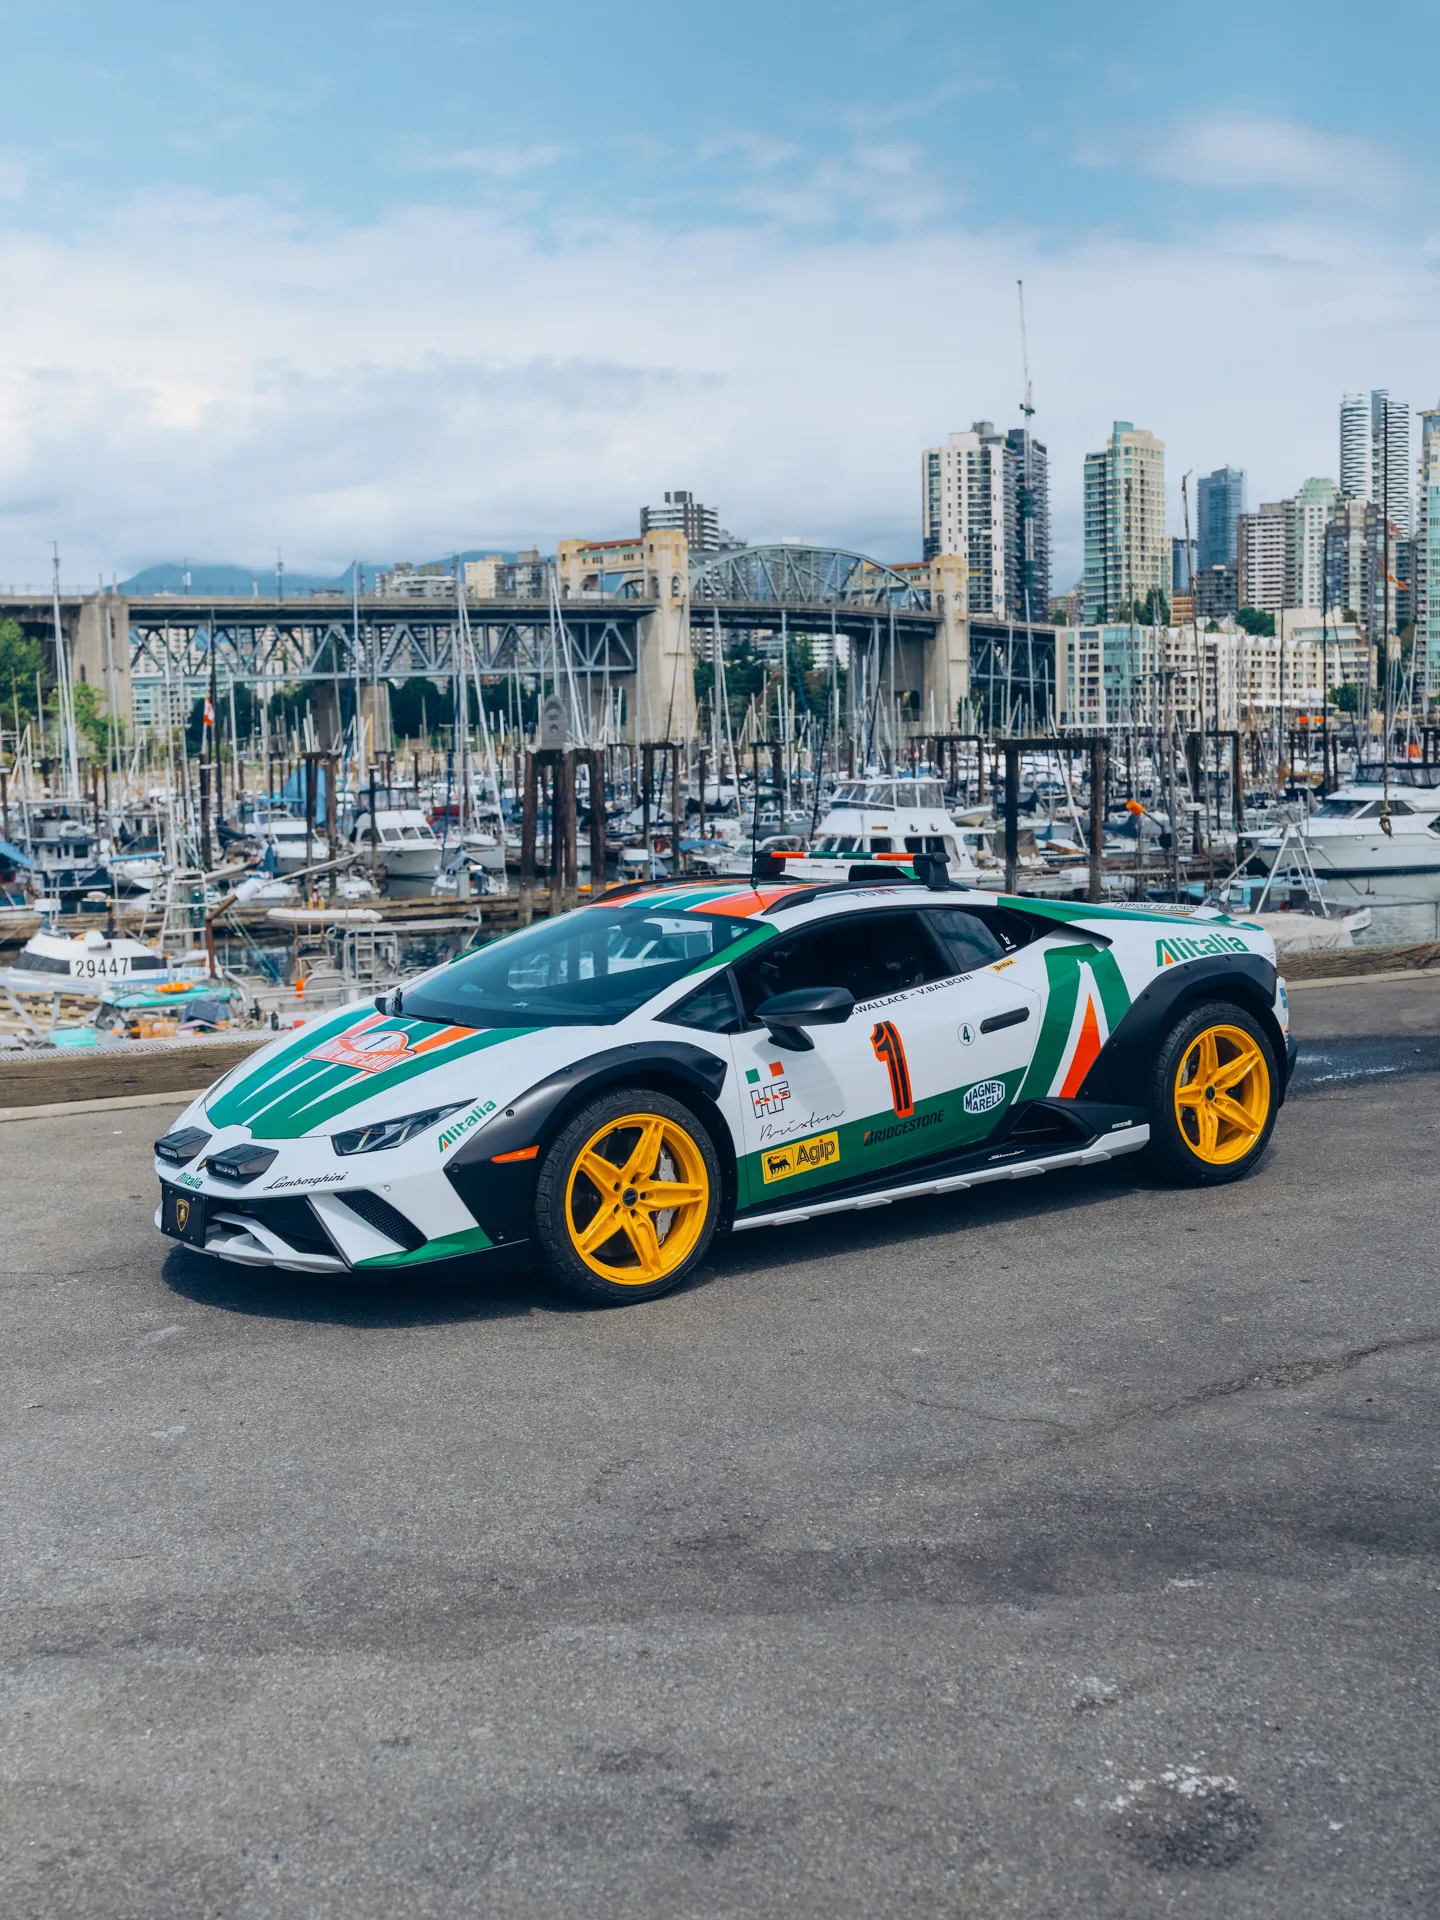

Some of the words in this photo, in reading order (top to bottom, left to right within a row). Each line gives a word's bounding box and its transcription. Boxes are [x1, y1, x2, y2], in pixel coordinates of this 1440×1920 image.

[1155, 933, 1250, 968] Alitalia
[75, 957, 129, 978] 29447
[962, 1025, 971, 1043] 4
[870, 1020, 914, 1119] 1
[750, 1081, 791, 1119] HF
[965, 1082, 1004, 1104] MAGNETI
[438, 1100, 497, 1153] Alitalia
[864, 1110, 945, 1147] BRIDGESTONE
[797, 1139, 835, 1165] Agip
[175, 1172, 203, 1189] Alitalia
[263, 1171, 349, 1191] Lamborghini
